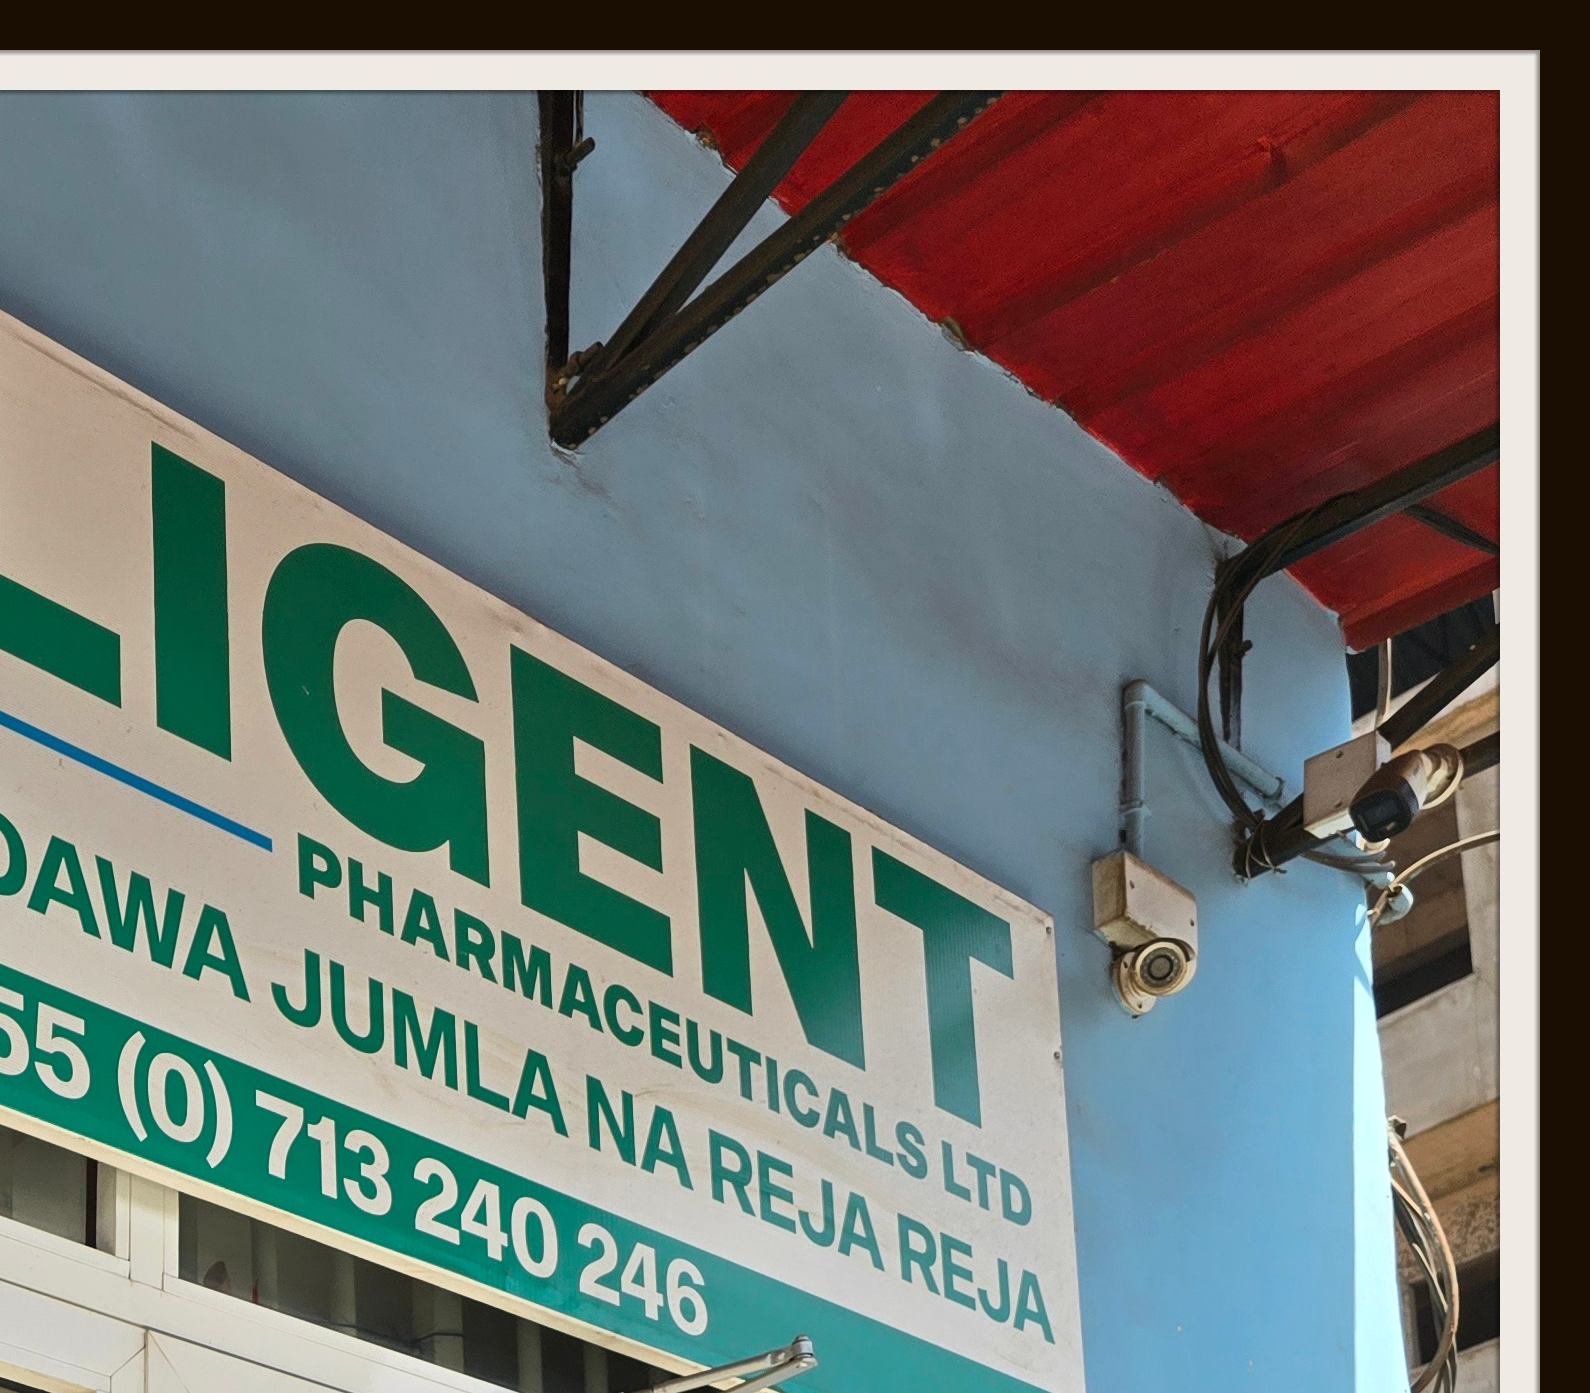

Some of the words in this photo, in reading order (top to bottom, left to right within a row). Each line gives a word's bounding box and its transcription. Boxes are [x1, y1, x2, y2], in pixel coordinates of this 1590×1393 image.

[117, 1031, 233, 1169] (0)
[255, 1089, 393, 1217] 713
[414, 1158, 559, 1278] 240
[577, 1223, 708, 1336] 246
[272, 949, 568, 1138] JUMLA
[587, 1075, 692, 1189] NA
[709, 1128, 883, 1270] REJA
[898, 1210, 1055, 1343] REJA
[298, 833, 927, 1179] PHARMACEUTICALS
[944, 1142, 1032, 1226] LTD
